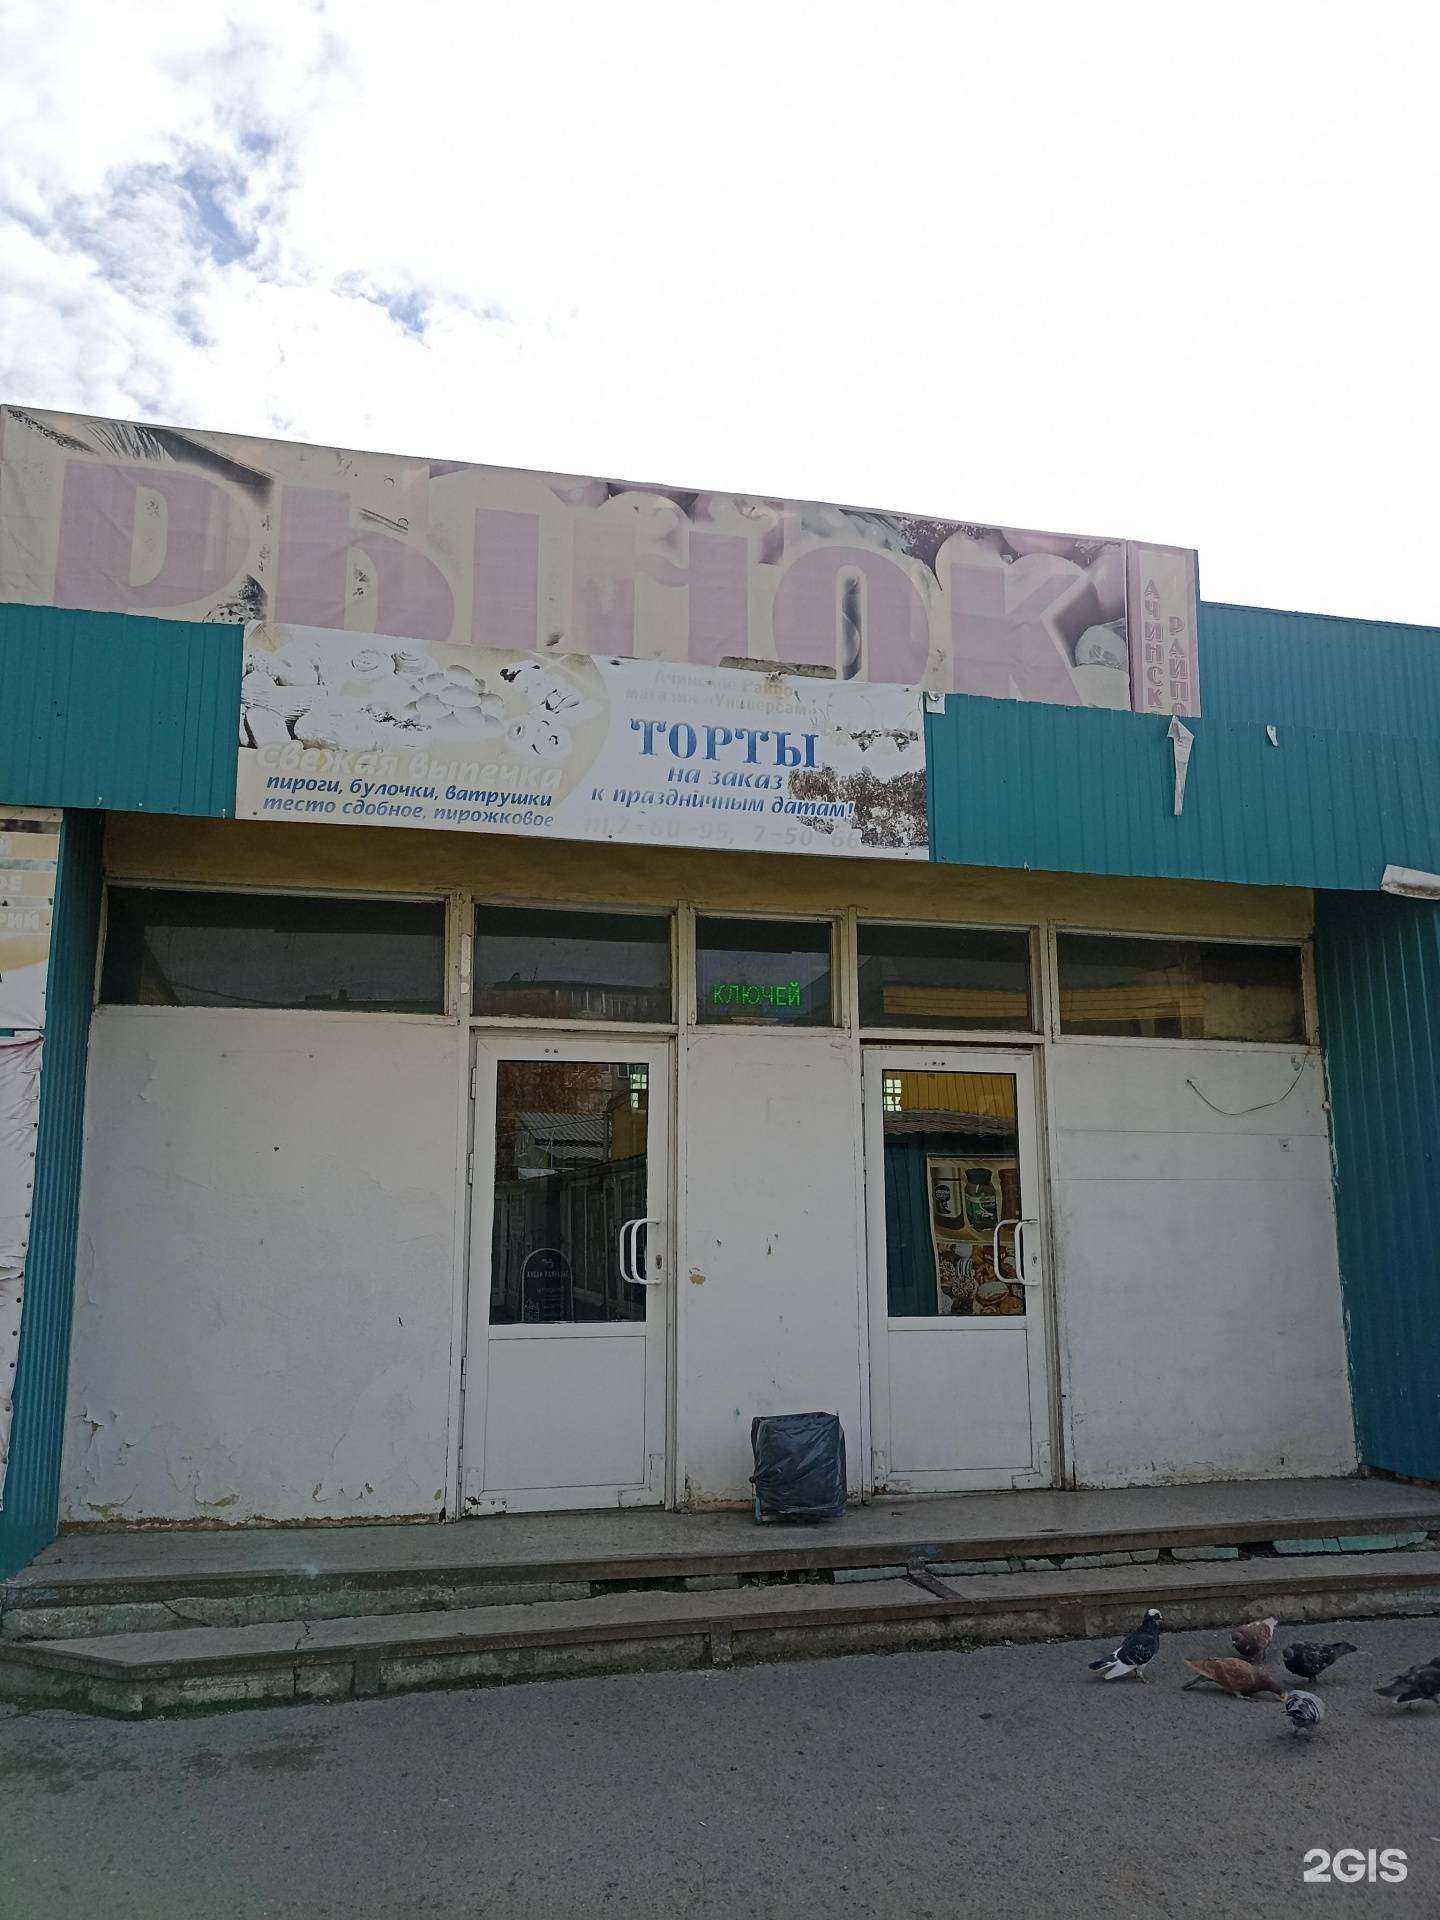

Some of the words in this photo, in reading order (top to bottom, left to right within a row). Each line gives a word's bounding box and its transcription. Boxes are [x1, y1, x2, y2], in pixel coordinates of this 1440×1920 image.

[1144, 578, 1165, 709] АЧИНСК
[630, 718, 819, 767] ТОРТЫ
[267, 776, 343, 795] пироги,
[350, 779, 438, 800] булочки,
[445, 785, 552, 807] ватрушки
[667, 767, 700, 784] на
[708, 770, 783, 790] заказ
[263, 797, 336, 813] тесто
[342, 800, 426, 819] сдобное,
[434, 806, 553, 826] пирожковое
[591, 788, 604, 801] к
[613, 787, 764, 812] праздничным
[771, 795, 855, 818] датам!
[713, 981, 801, 1006] КЛЮЧЕЙ
